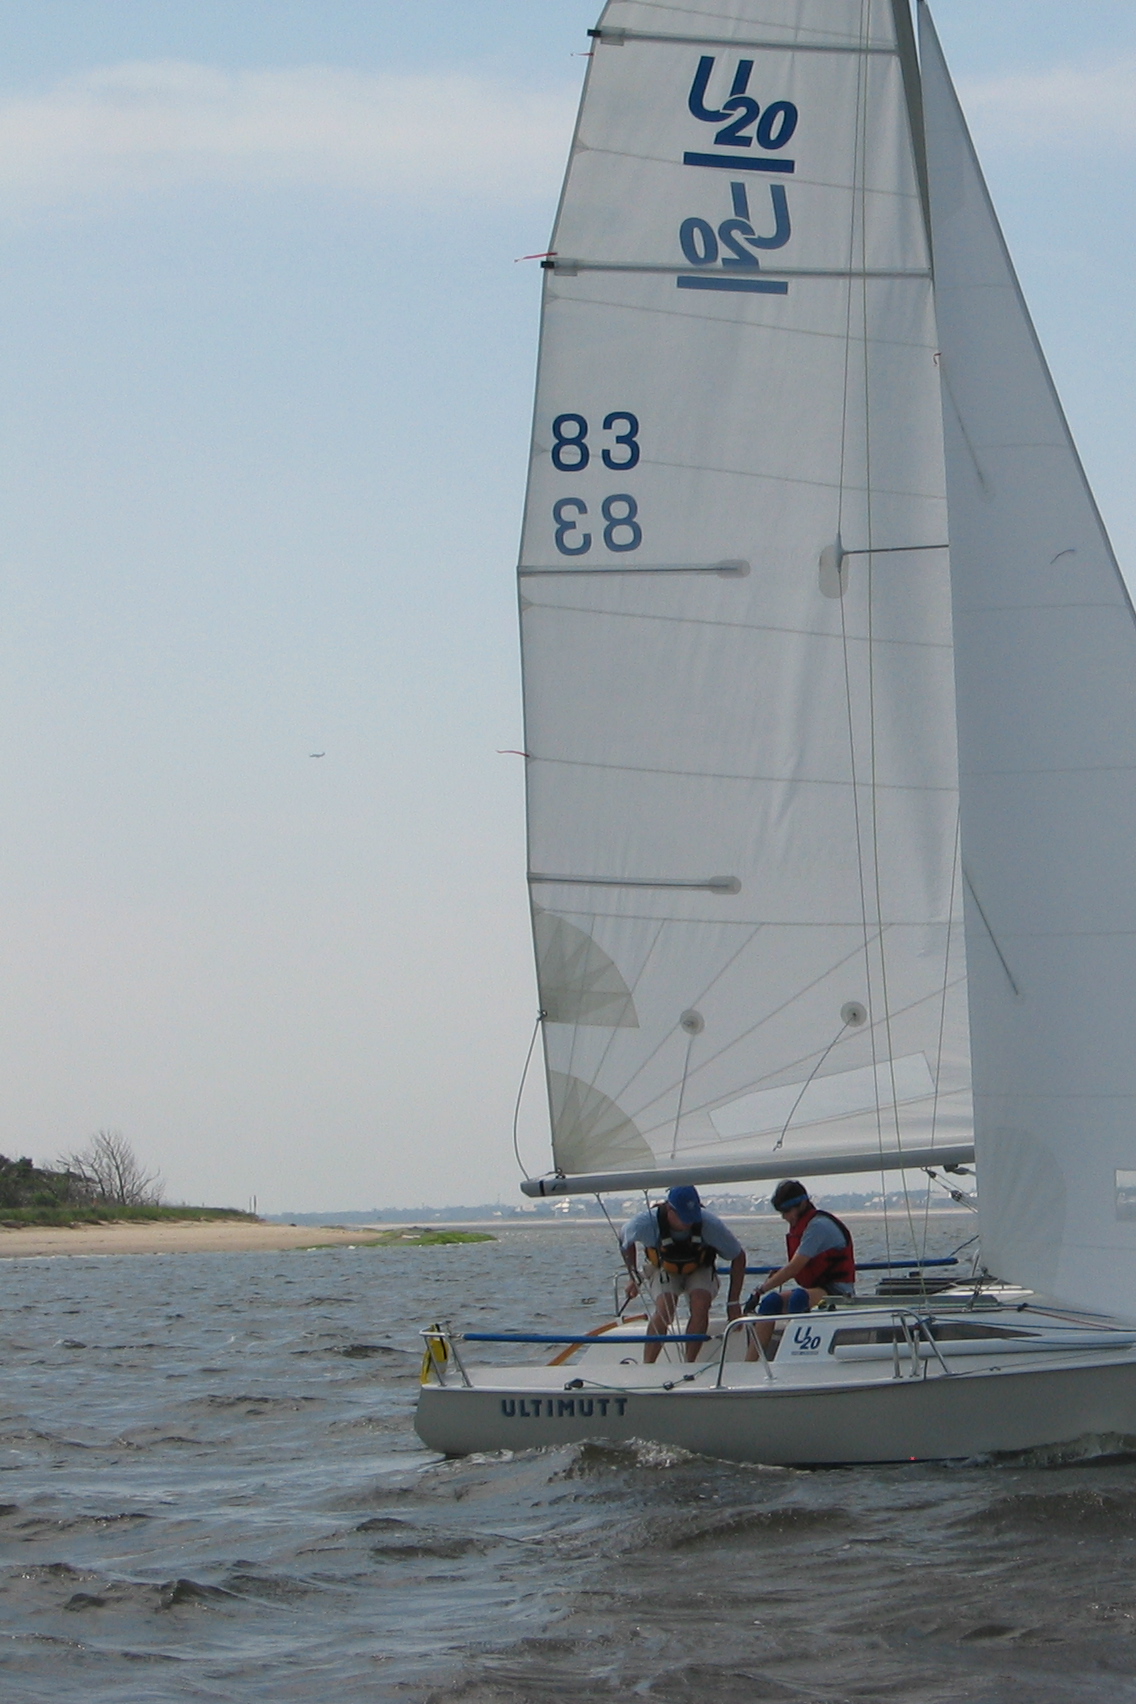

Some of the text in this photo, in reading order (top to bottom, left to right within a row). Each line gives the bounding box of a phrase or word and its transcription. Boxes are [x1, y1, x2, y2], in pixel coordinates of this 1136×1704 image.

[688, 55, 798, 150] U20
[551, 411, 640, 472] 83
[794, 1326, 821, 1350] U20
[501, 1398, 628, 1417] ULTIMUTT
